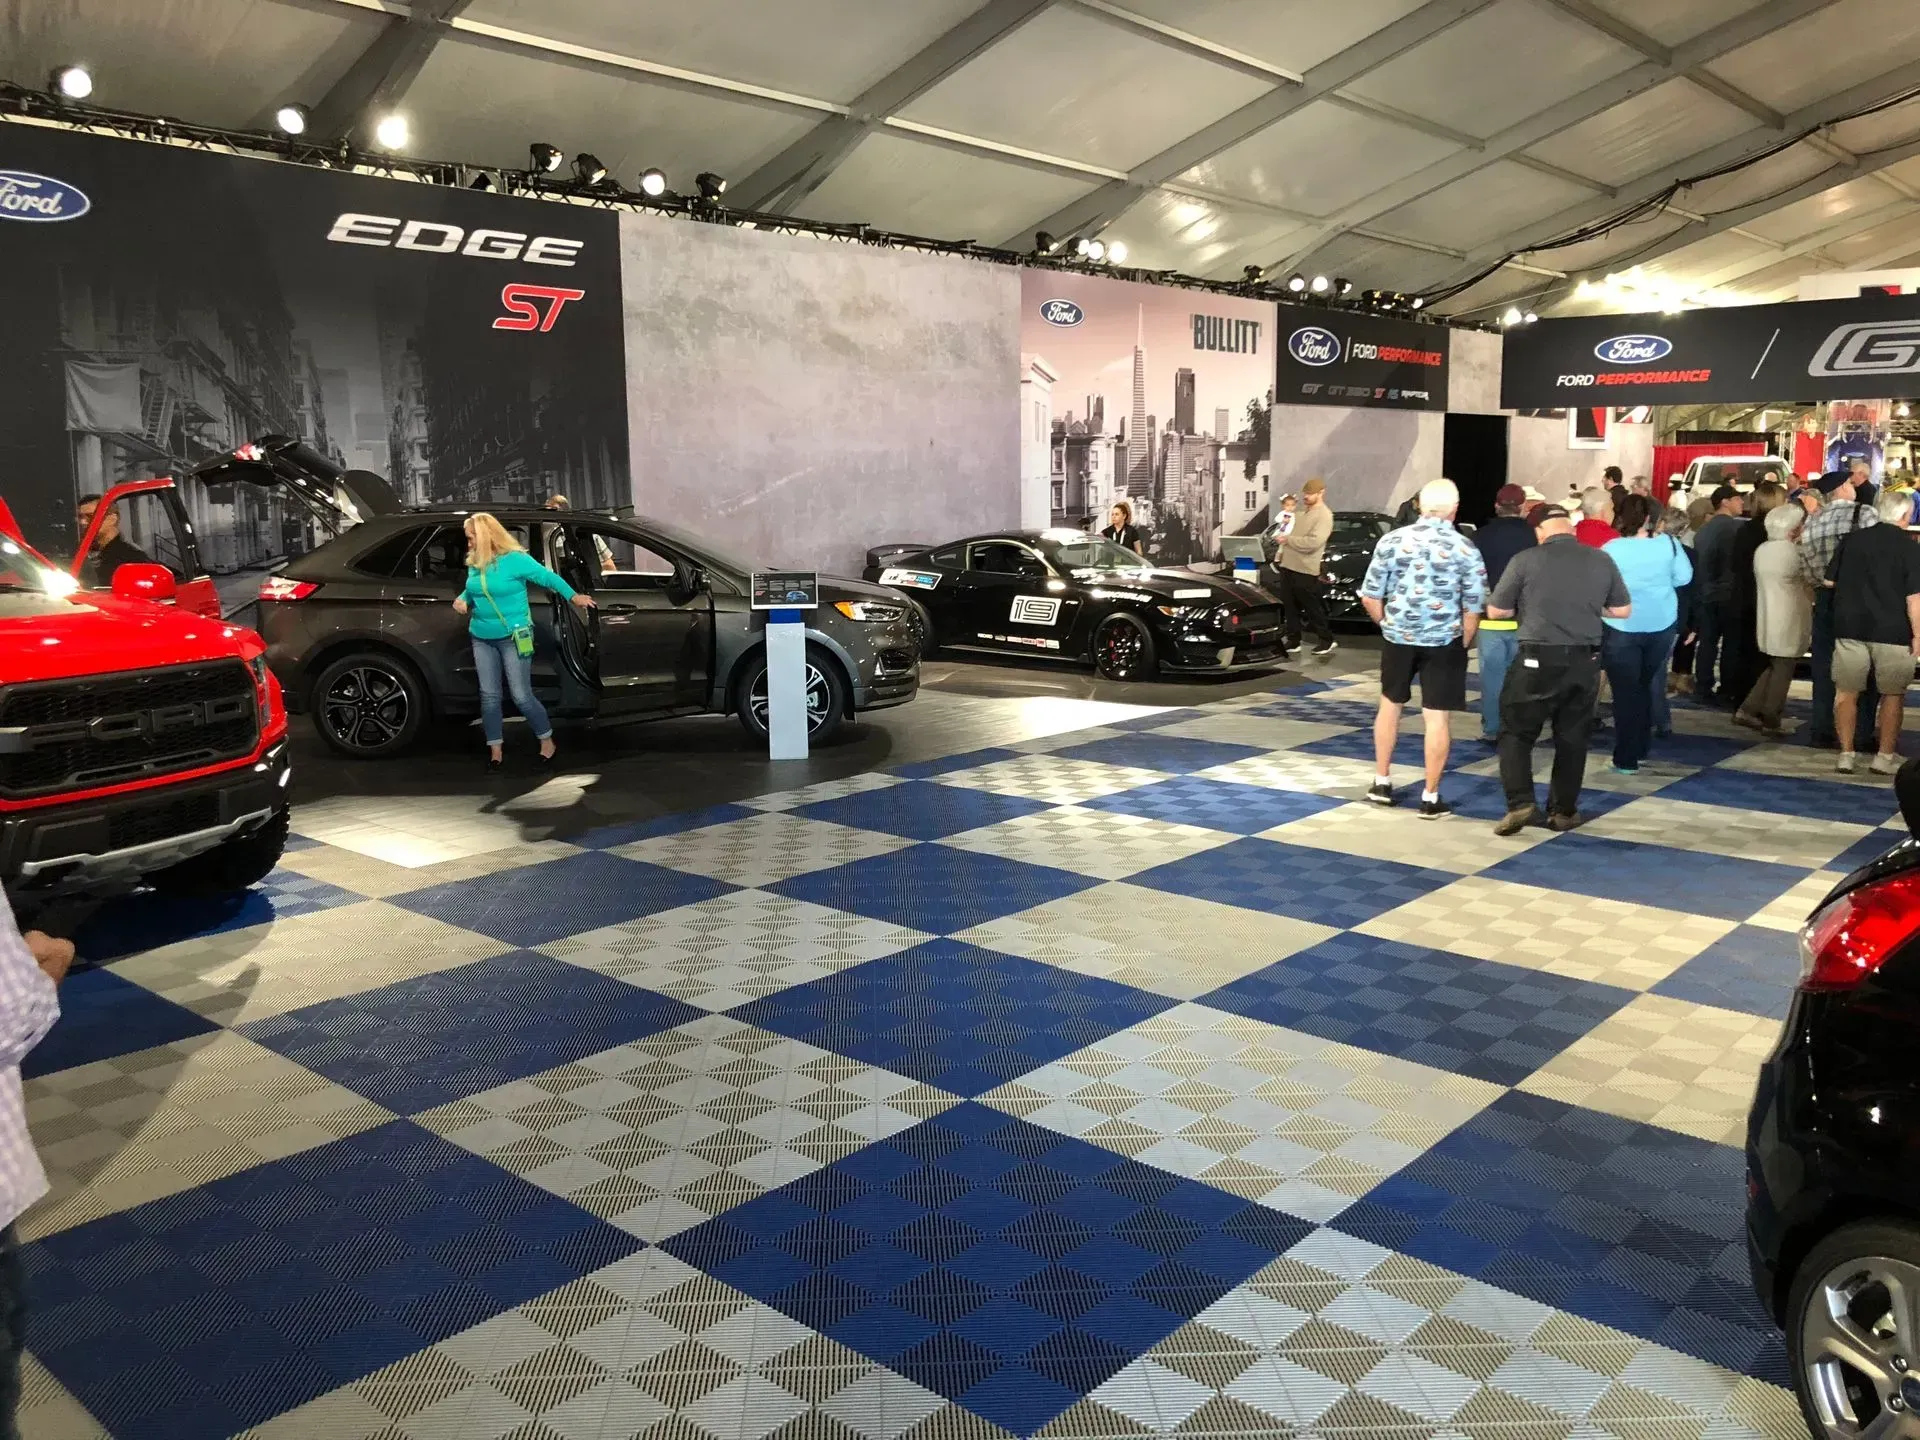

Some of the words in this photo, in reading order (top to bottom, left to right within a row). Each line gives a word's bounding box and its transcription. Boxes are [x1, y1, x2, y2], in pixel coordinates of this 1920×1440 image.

[0, 175, 63, 215] Ford
[327, 213, 584, 267] EDGE
[492, 283, 586, 333] ST
[1047, 302, 1077, 324] Ford
[1192, 313, 1261, 354] BULLITT
[1298, 331, 1331, 360] Ford
[1352, 343, 1377, 360] FORD
[1377, 345, 1442, 366] PERFORMANCE
[1608, 338, 1658, 359] Ford
[1556, 374, 1594, 387] FORD
[1594, 368, 1712, 386] PERFORMANCE
[1013, 598, 1057, 622] 19
